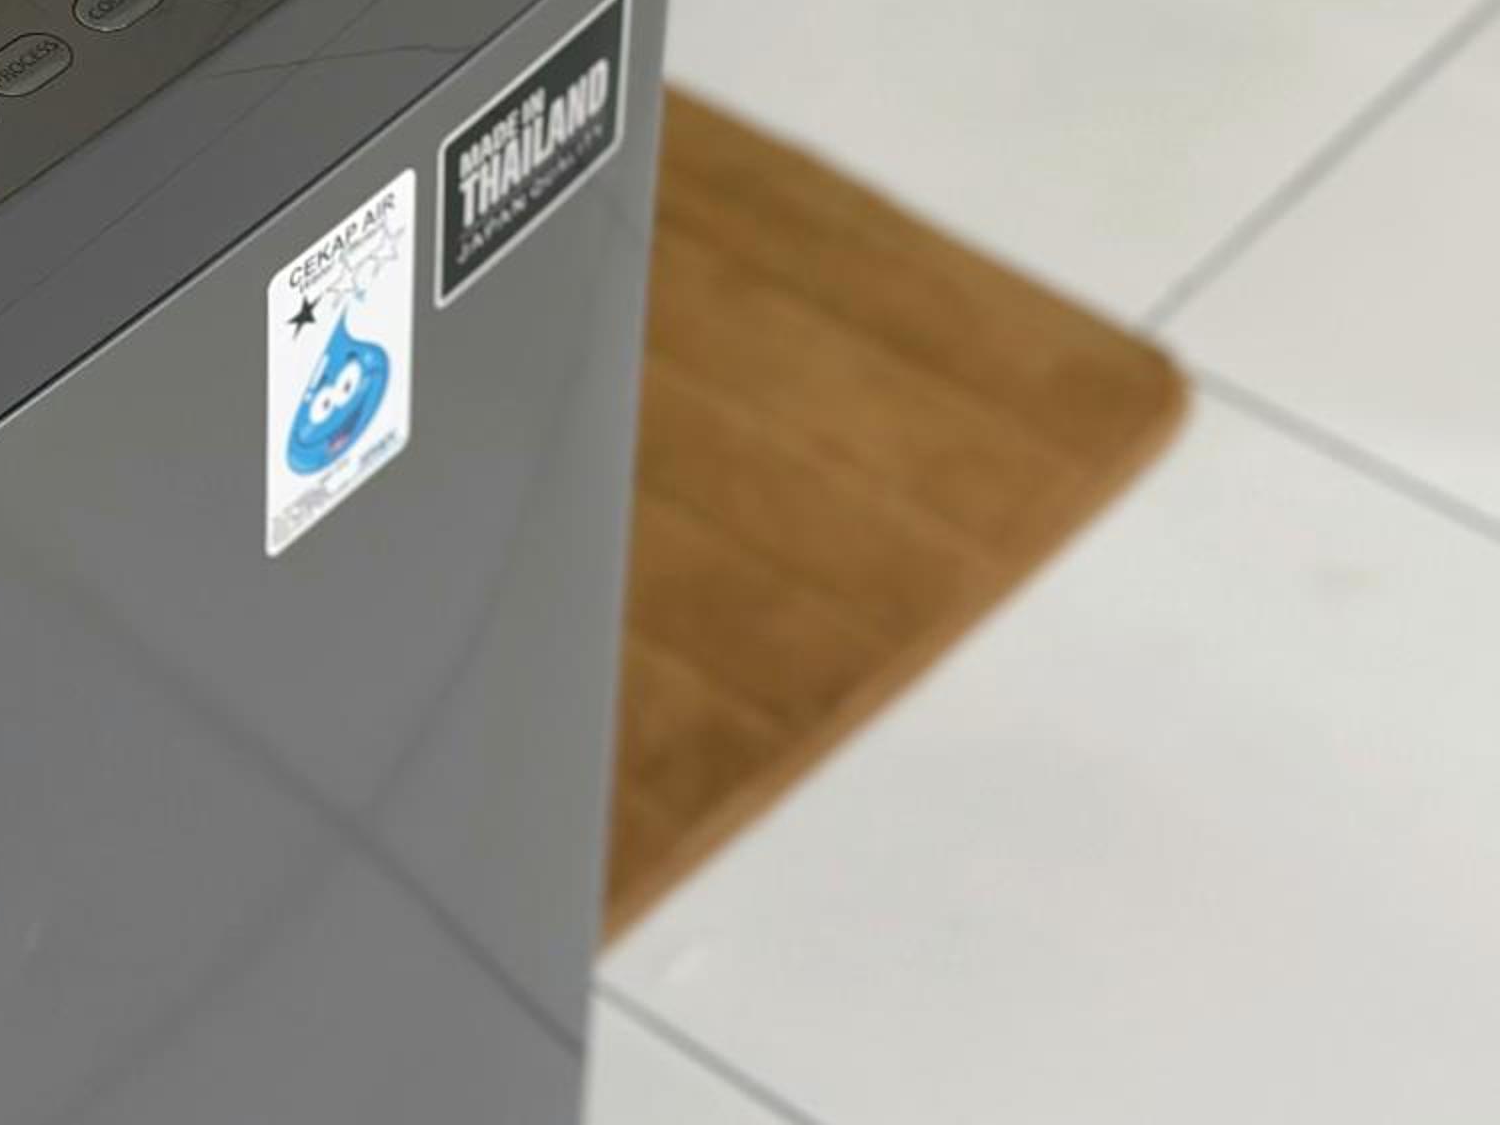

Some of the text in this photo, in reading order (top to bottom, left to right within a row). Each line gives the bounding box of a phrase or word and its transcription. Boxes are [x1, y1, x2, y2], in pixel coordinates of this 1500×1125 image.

[459, 87, 547, 180] MADE IN
[459, 58, 609, 229] THAILAND
[289, 221, 358, 288] CEKAP
[362, 192, 396, 233] AIR
[456, 192, 528, 265] JAPAN
